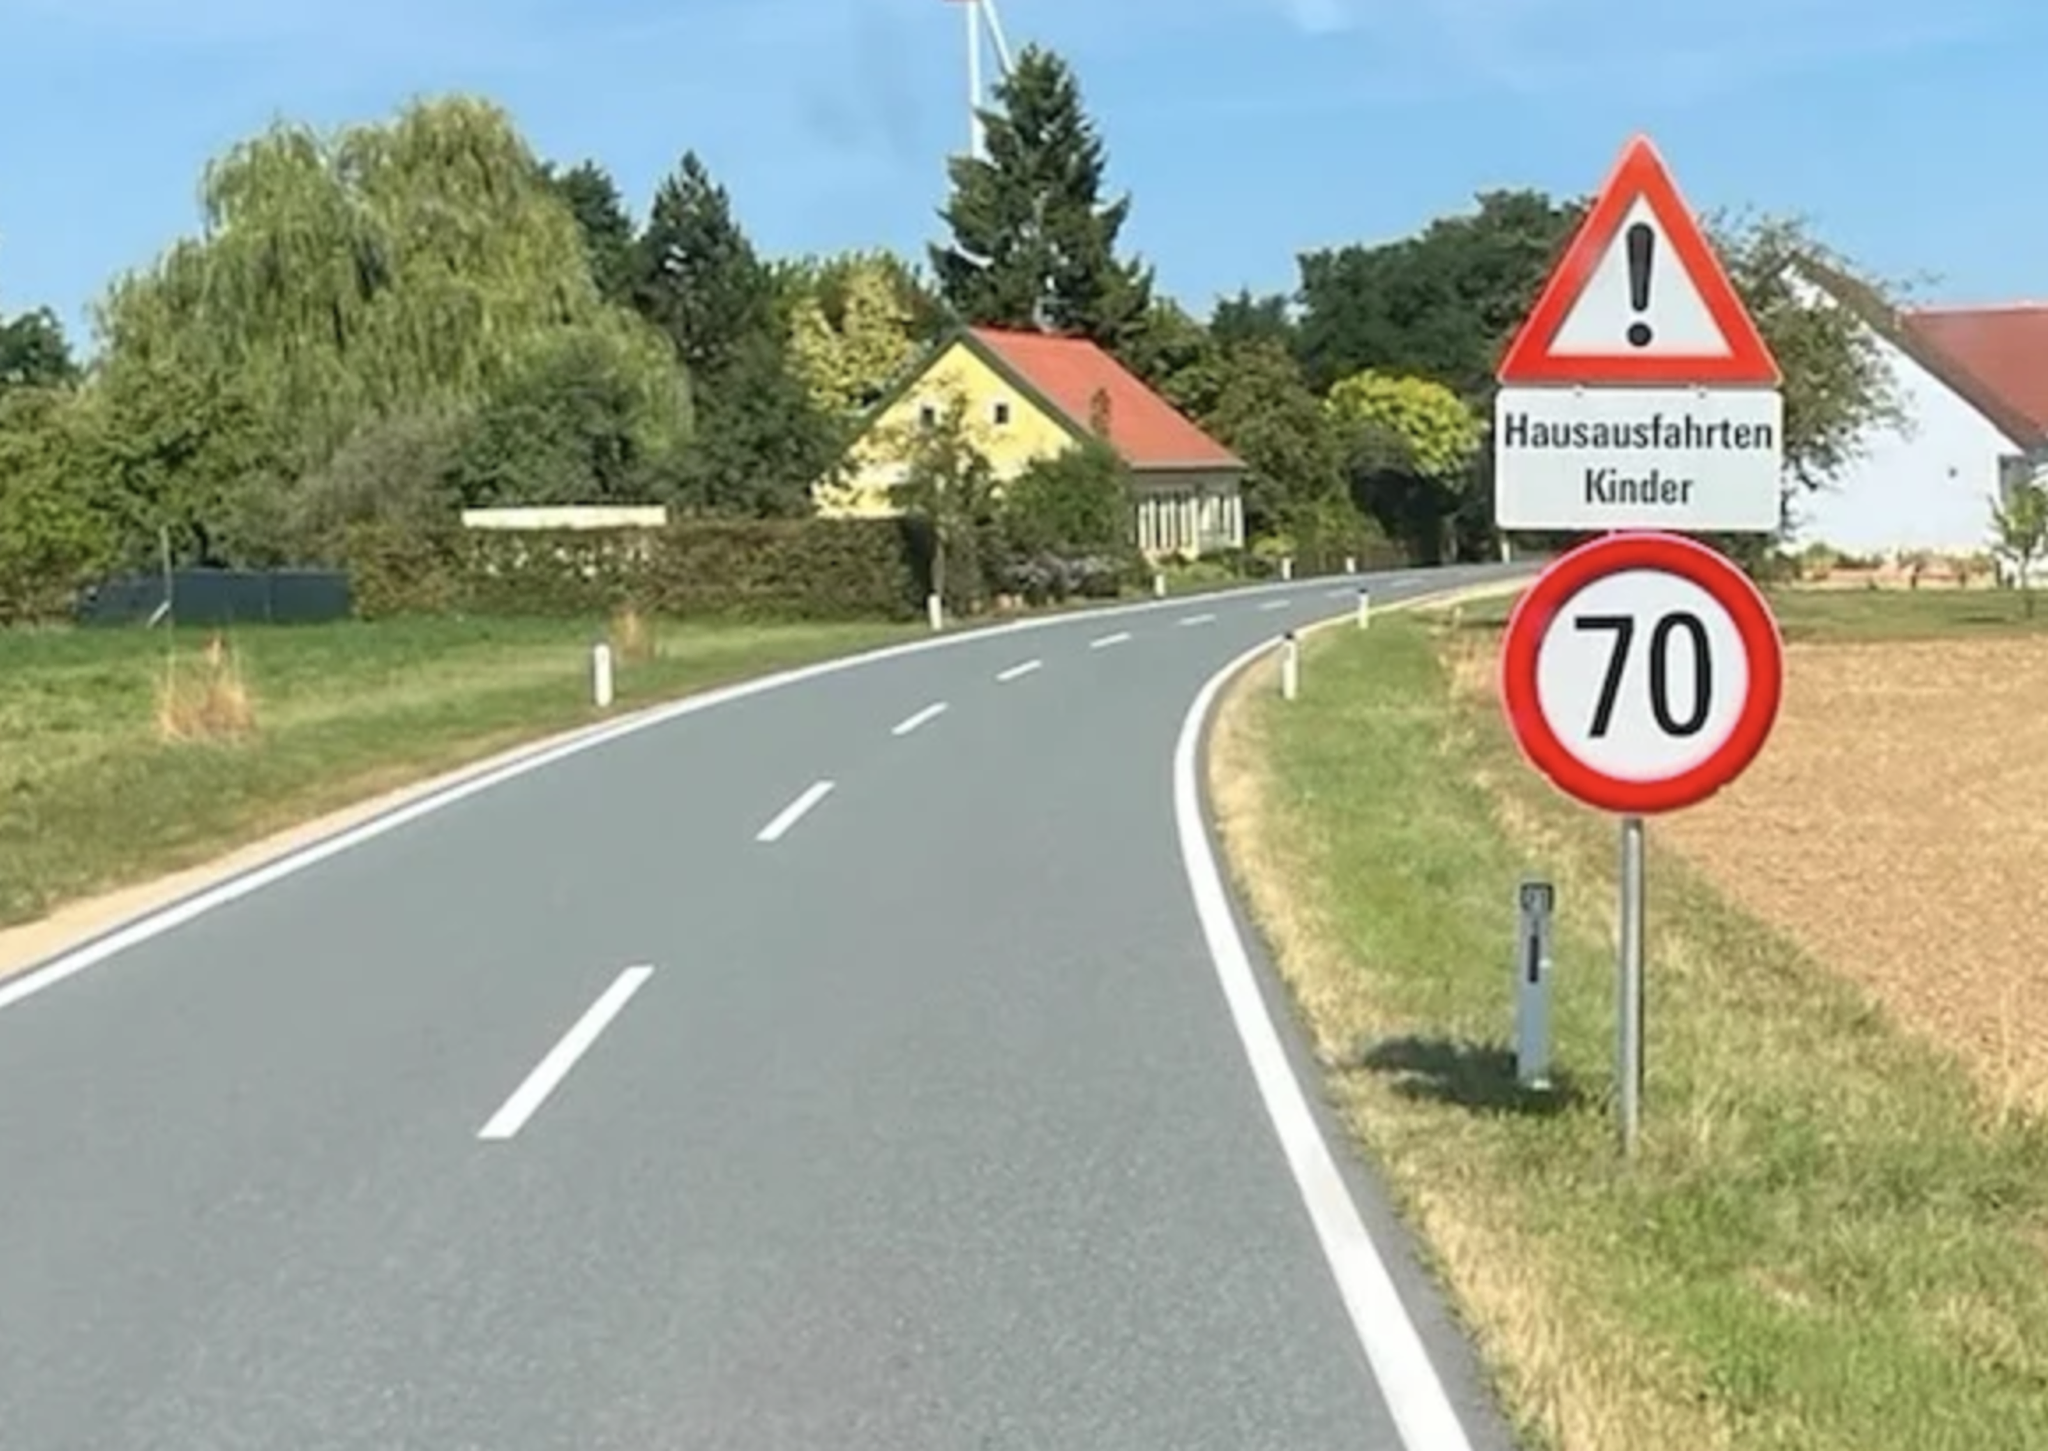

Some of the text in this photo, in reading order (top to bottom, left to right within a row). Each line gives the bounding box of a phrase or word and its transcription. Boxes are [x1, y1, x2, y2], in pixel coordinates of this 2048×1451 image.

[1504, 413, 1772, 449] Hausausfahrten
[1585, 468, 1694, 504] Kinder
[1574, 611, 1713, 738] 70
